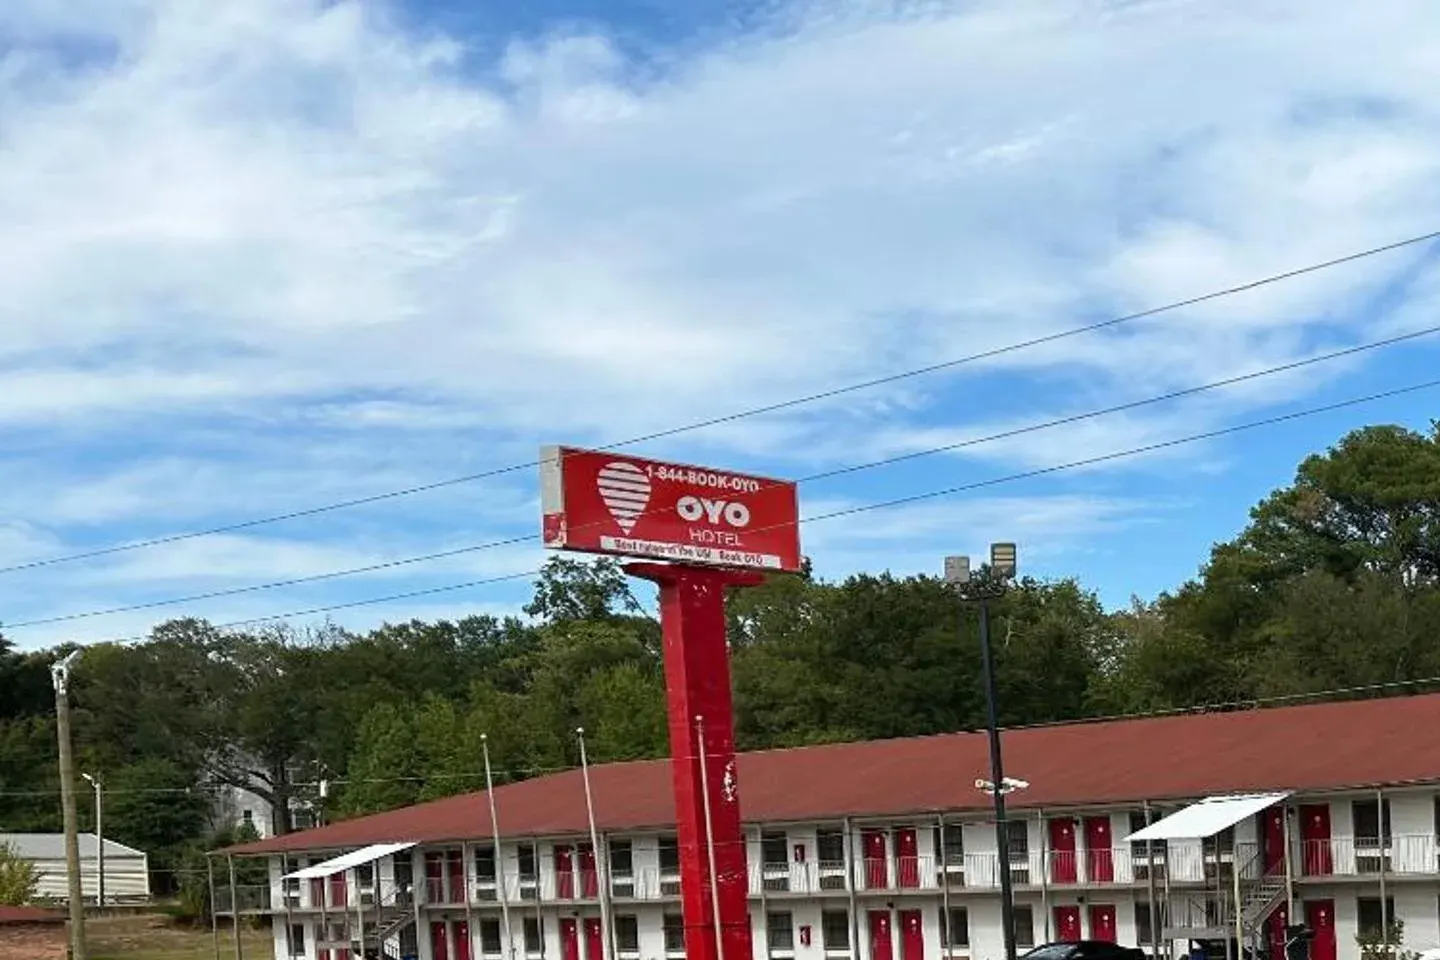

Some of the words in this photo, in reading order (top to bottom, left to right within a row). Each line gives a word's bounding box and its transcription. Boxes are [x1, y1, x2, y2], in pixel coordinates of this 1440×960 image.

[645, 465, 760, 493] 1-844-BOOK-OYO
[676, 495, 750, 528] OYO
[689, 527, 744, 546] HOTEL
